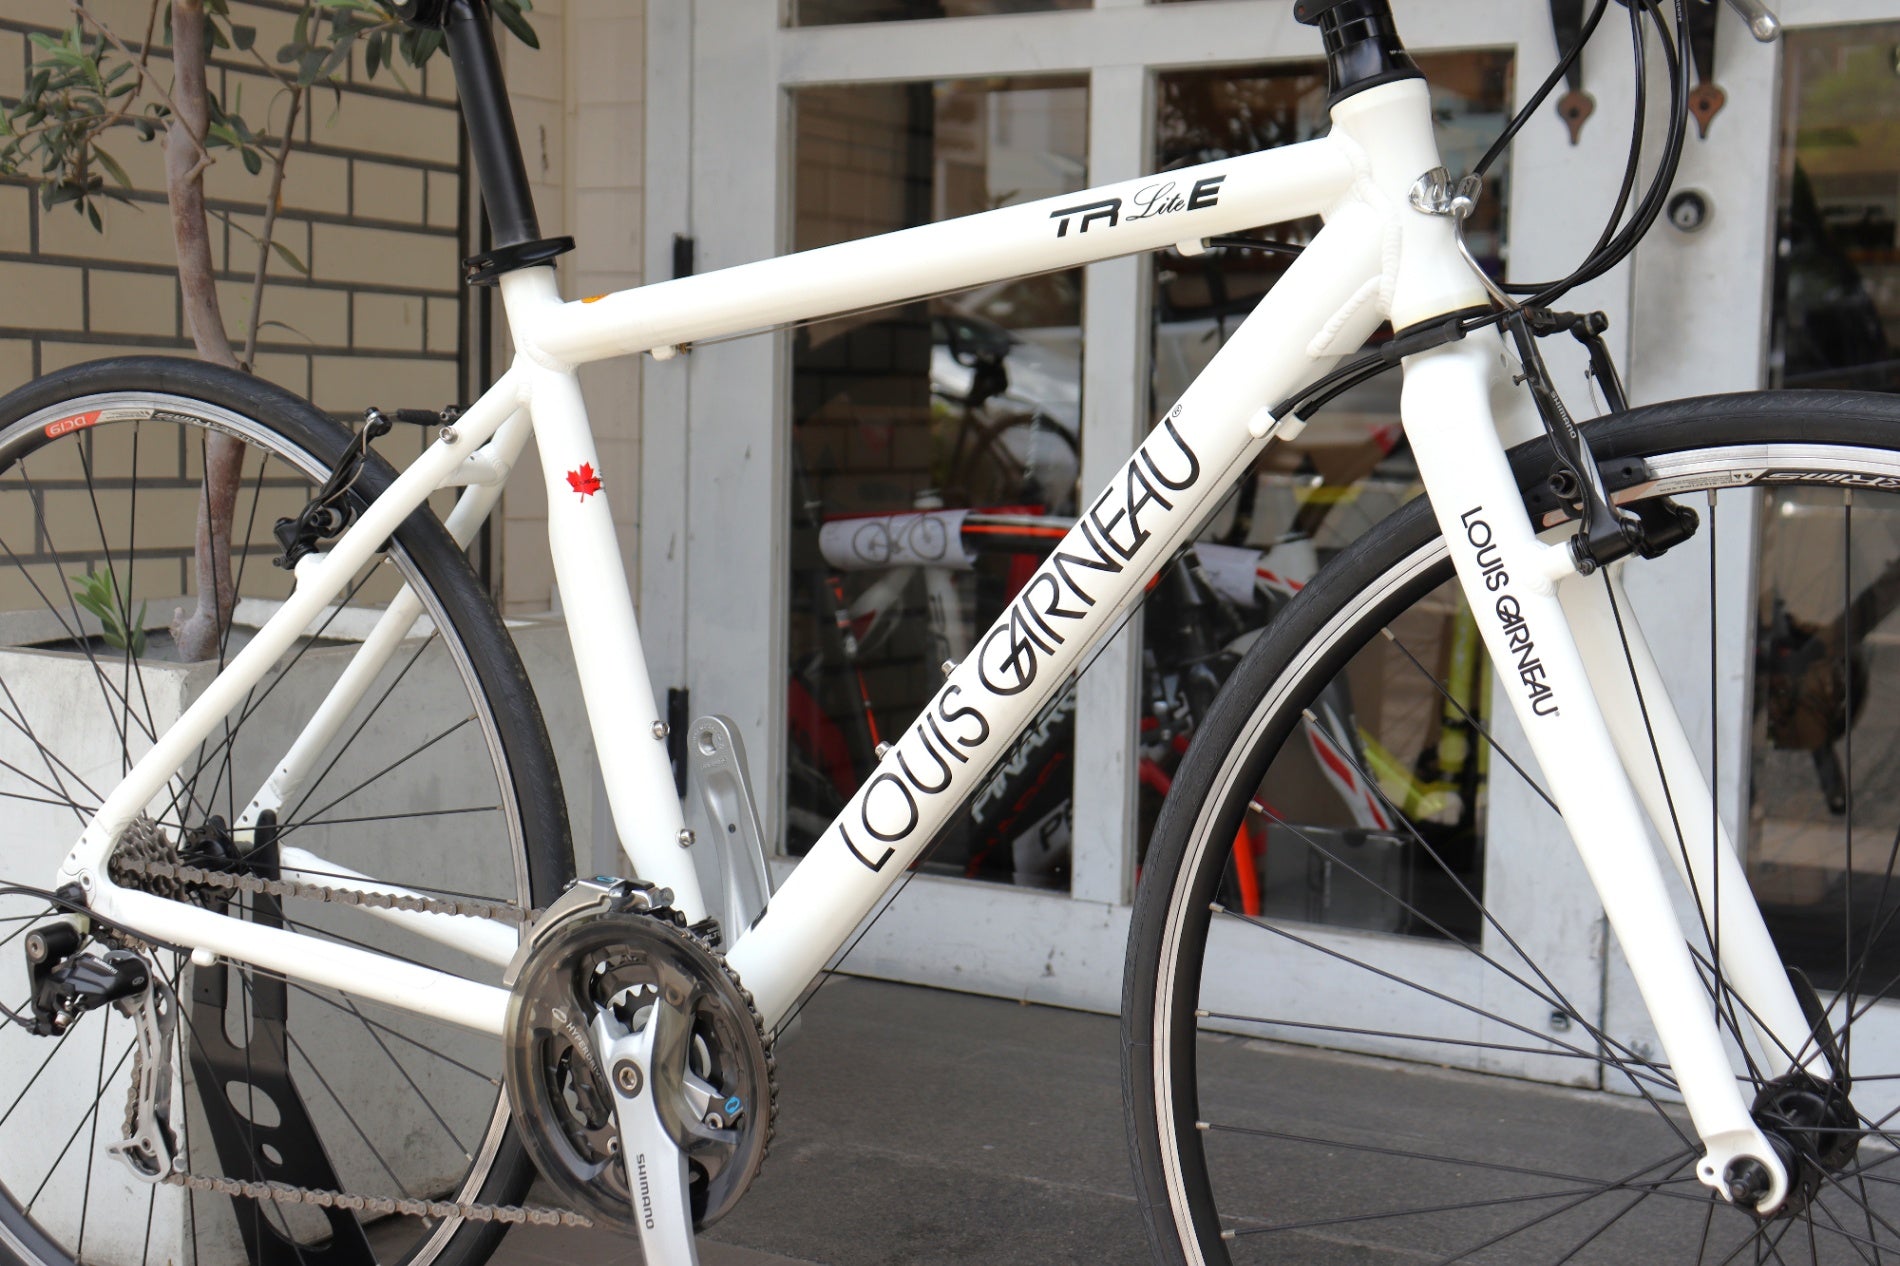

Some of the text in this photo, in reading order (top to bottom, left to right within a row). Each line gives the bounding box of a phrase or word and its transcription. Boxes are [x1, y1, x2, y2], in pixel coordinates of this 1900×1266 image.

[1125, 181, 1186, 222] Lite
[50, 416, 86, 435] DC19
[1550, 390, 1577, 439] SHIMANO
[1460, 505, 1559, 717] LOUIS GARNEAU
[839, 417, 1201, 873] LOUIS GARNEAU
[566, 1022, 604, 1081] HYPERDRIV
[636, 1152, 655, 1230] SHIMANO
